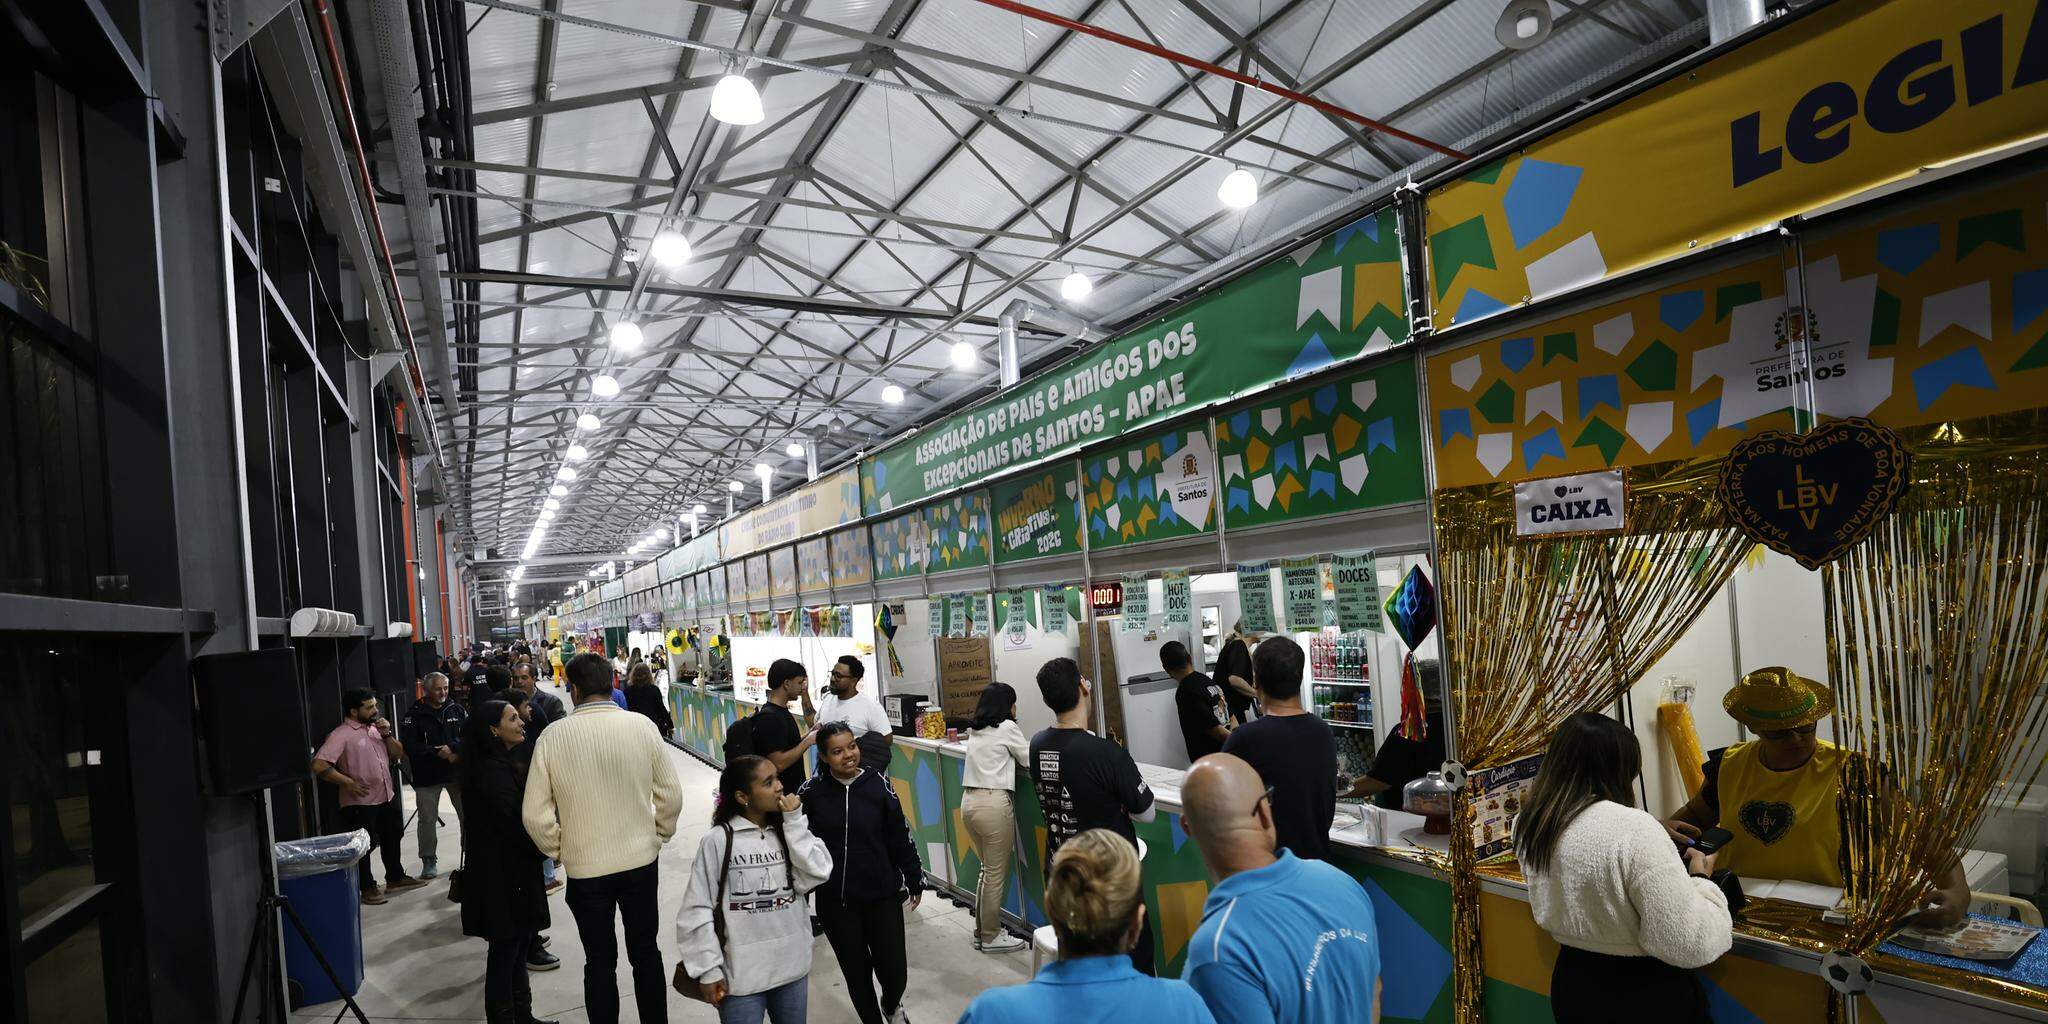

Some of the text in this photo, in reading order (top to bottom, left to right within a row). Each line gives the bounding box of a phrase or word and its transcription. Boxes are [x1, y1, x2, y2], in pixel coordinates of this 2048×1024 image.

[1828, 350, 1846, 360] DE
[1757, 363, 1847, 392] Santos
[915, 415, 985, 466] ASSOCIAÇÃO
[1009, 390, 1045, 427] PAIS
[1063, 346, 1143, 405] AMIGOS
[1148, 321, 1197, 370] DOS
[1035, 403, 1105, 454] SANTOS
[1126, 371, 1186, 421] APAE
[1569, 486, 1584, 494] LBV
[1731, 430, 1889, 541] PAZ NA TERRA AOS HOMENS DE BOA VONTADE
[1178, 488, 1208, 502] Santos
[1531, 498, 1613, 524] CAIXA
[1037, 530, 1061, 554] 2026
[1339, 568, 1370, 583] DOCES
[1168, 583, 1187, 596] HOT-
[1290, 588, 1315, 600] X-APAE
[1169, 597, 1187, 609] DOG
[1169, 613, 1188, 622] R$15.00
[1041, 771, 1059, 779] SANTOS
